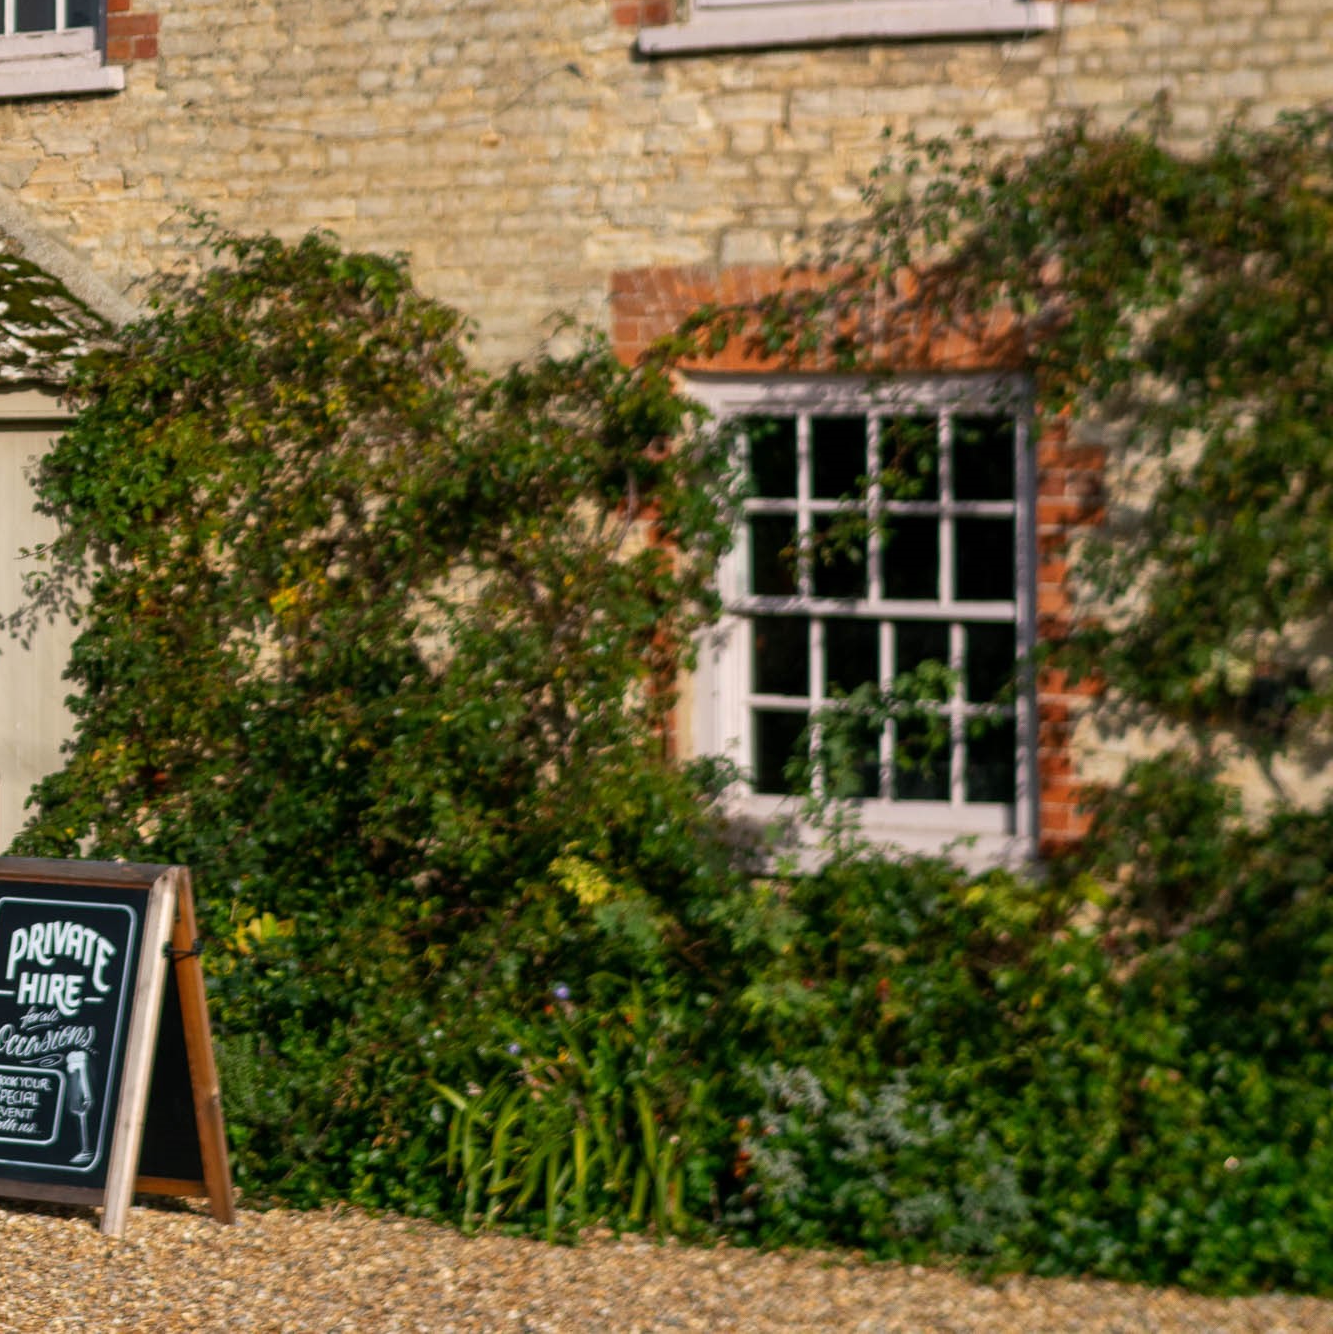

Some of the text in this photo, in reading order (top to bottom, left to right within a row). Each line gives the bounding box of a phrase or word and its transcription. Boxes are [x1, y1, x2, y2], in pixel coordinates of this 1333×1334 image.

[4, 920, 117, 993] PRIVATE
[16, 971, 86, 1017] HIRE
[19, 1005, 60, 1029] for all
[20, 1076, 52, 1091] YOUR
